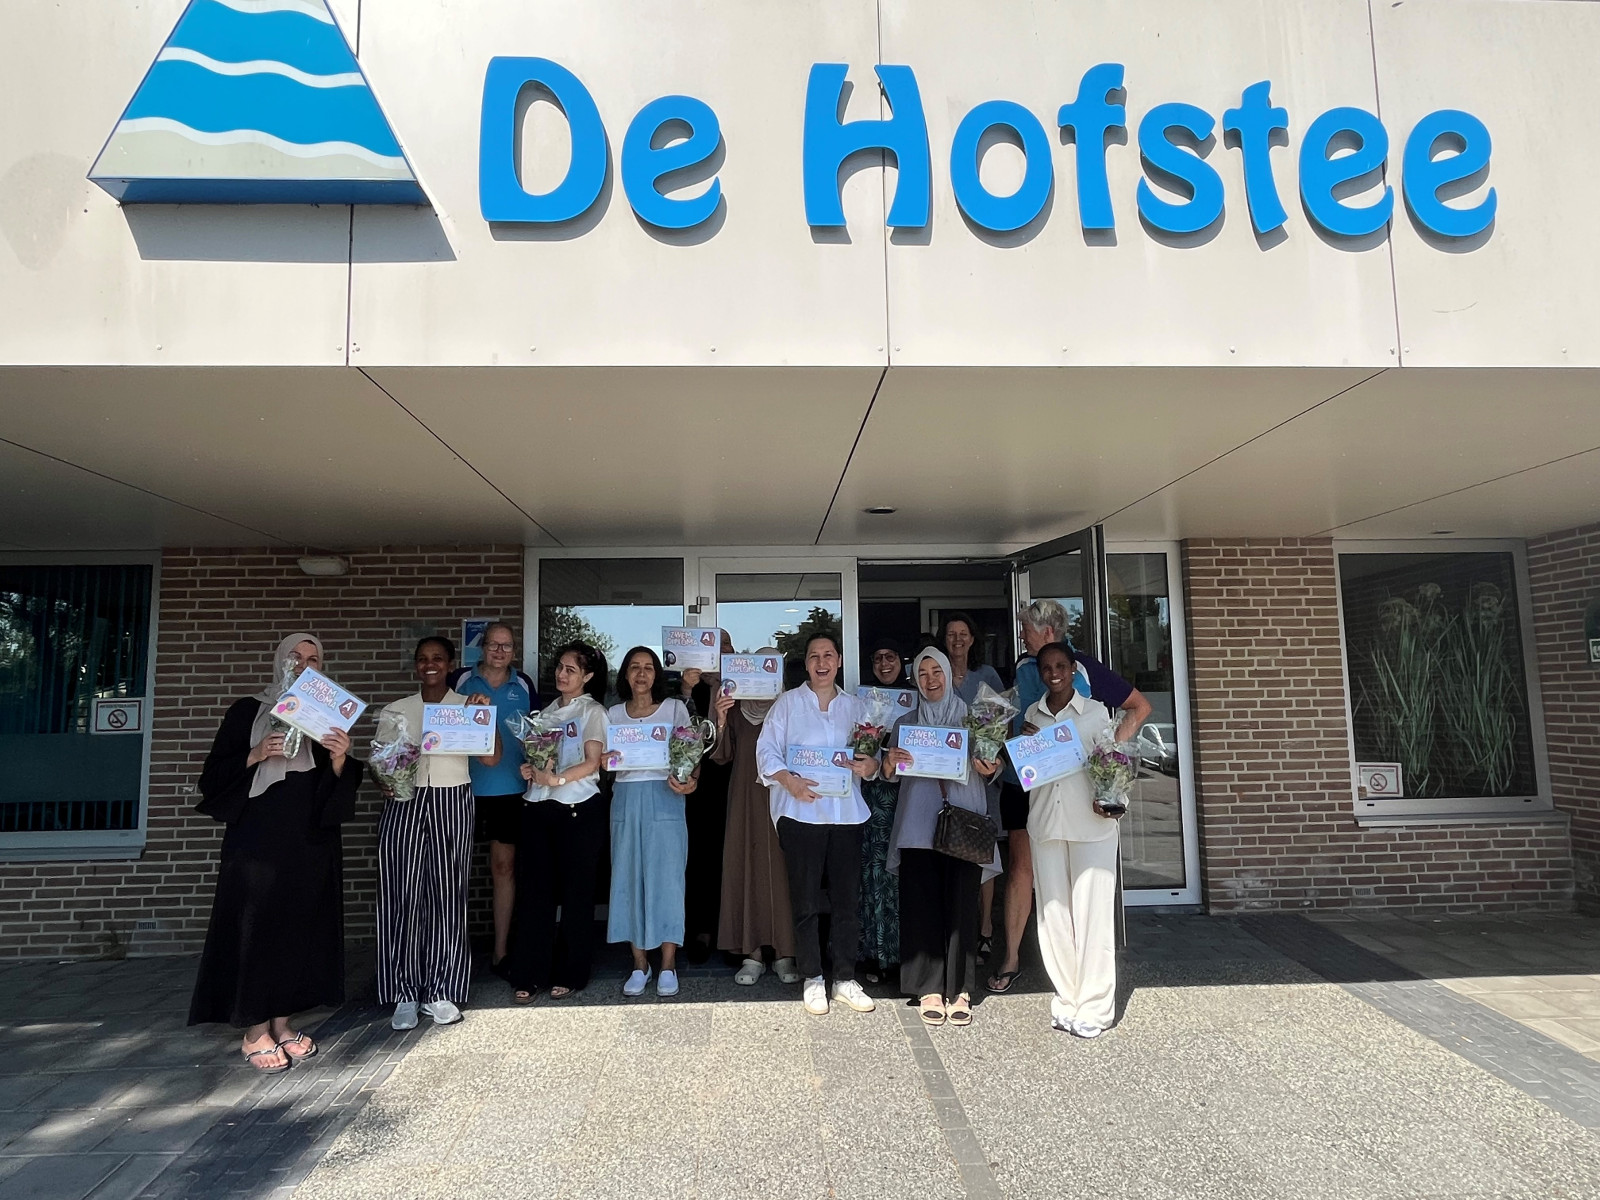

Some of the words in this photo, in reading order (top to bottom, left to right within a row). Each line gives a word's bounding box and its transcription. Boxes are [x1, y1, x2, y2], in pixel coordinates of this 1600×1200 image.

[480, 56, 721, 229] De
[803, 63, 1496, 237] Hofstee
[669, 631, 693, 639] ZWEM
[730, 657, 755, 667] ZWEM
[726, 665, 761, 674] DIPLOMA
[309, 677, 338, 698] ZWEM
[300, 682, 338, 711] DIPLOMA
[434, 708, 464, 717] ZWEM
[429, 716, 471, 726] DIPLOMA
[617, 726, 643, 736] ZWEM
[909, 729, 936, 739] ZWEM
[613, 734, 650, 744] DIPLOMA
[904, 737, 943, 748] DIPLOMA
[1017, 734, 1045, 750] ZWEM
[796, 749, 823, 758] ZWEM
[1016, 740, 1055, 759] DIPLOMA
[792, 757, 830, 767] DIPLOMA
